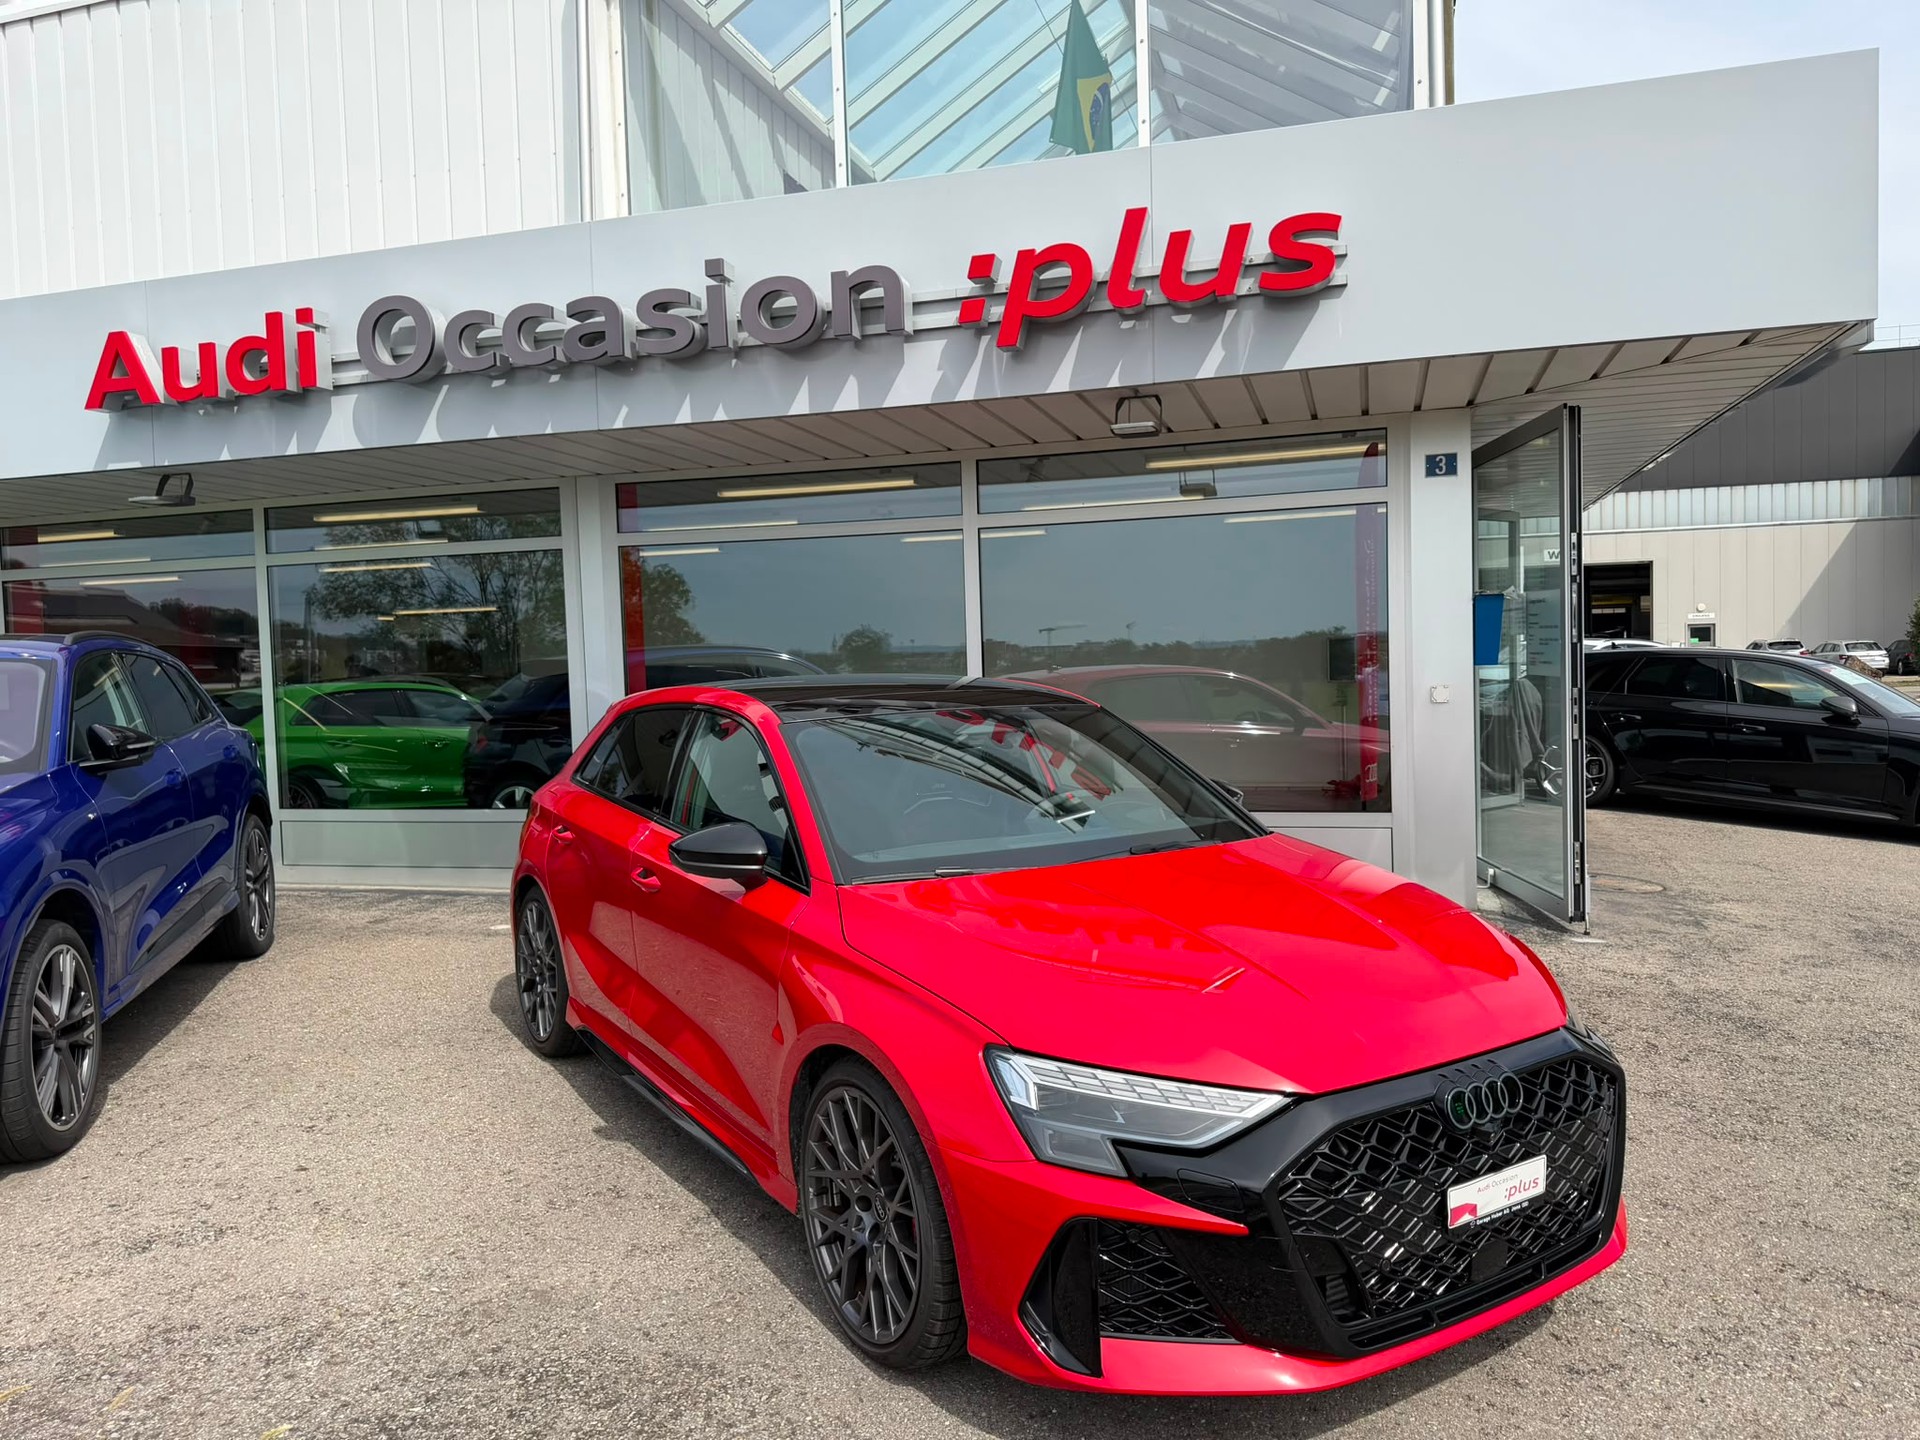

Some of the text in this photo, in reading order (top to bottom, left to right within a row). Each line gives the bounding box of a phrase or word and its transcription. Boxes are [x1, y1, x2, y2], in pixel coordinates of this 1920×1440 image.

[85, 207, 1344, 411] Audi Occasion :plus
[1435, 455, 1447, 475] 3
[1477, 1174, 1519, 1193] Audi Occasion
[1504, 1177, 1540, 1201] :plus
